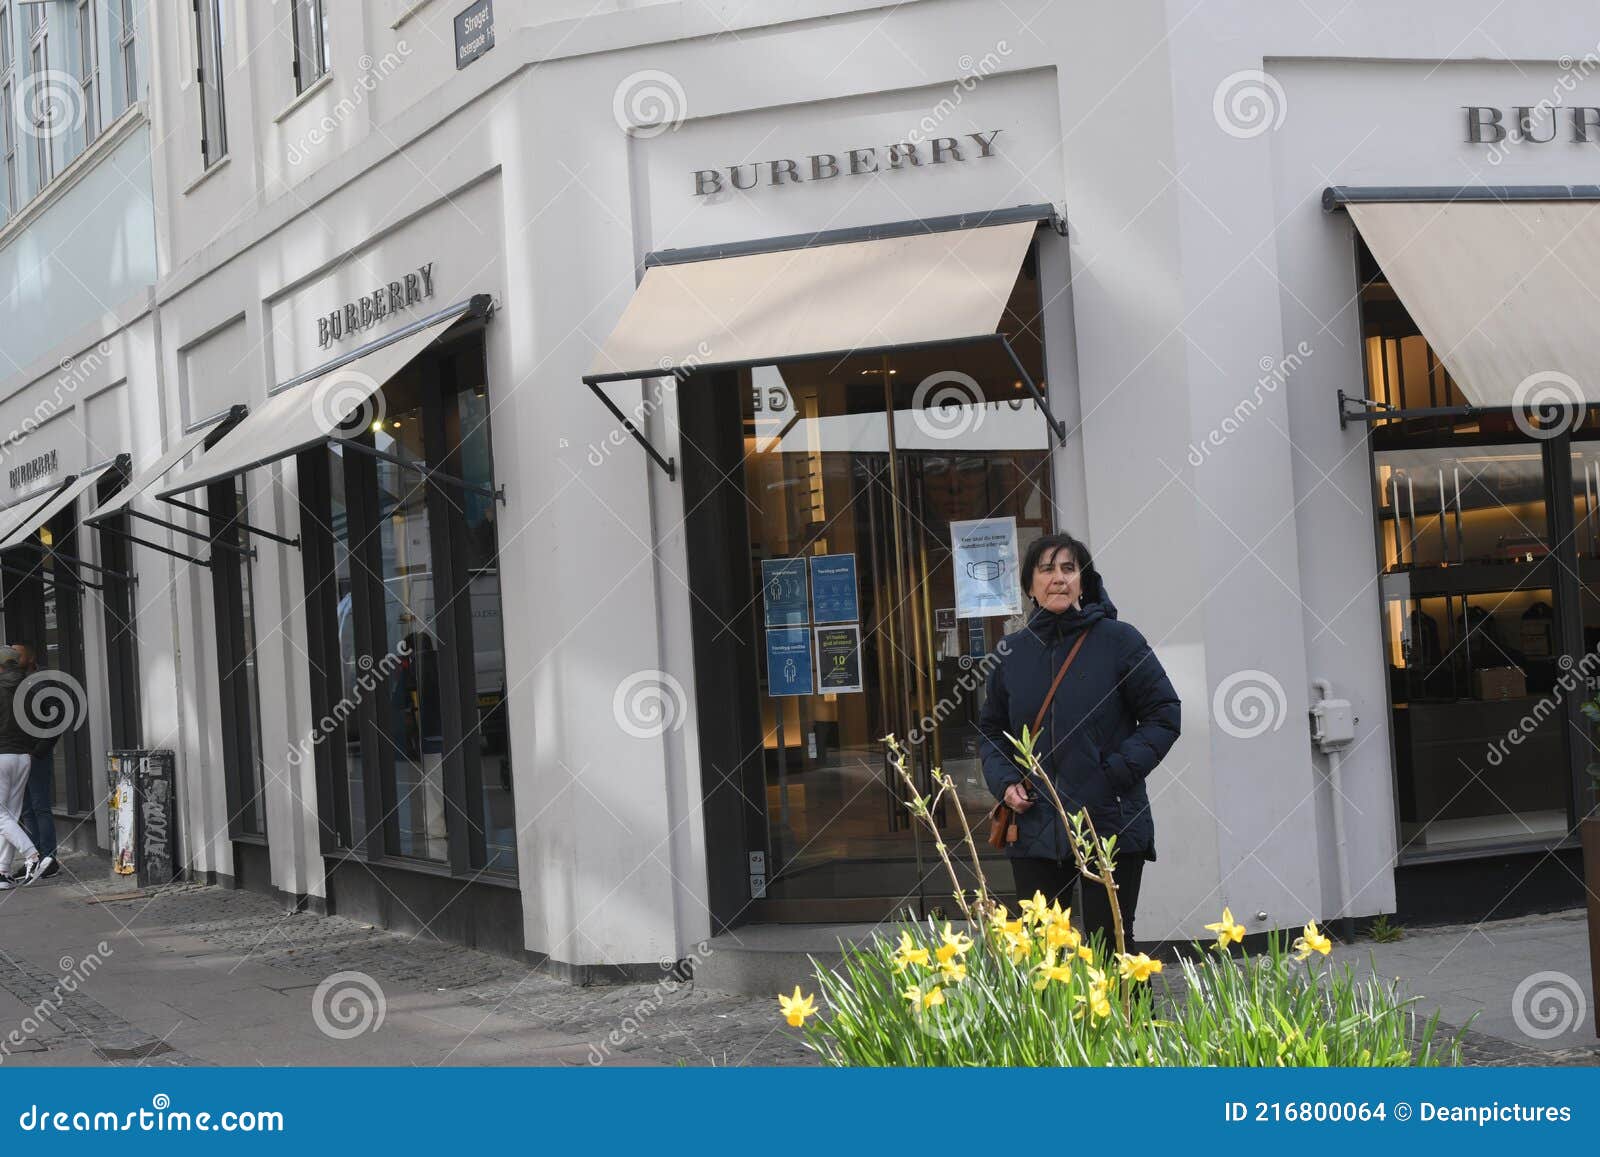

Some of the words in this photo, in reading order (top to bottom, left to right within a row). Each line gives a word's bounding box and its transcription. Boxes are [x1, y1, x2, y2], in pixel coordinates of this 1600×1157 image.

[689, 129, 1005, 196] BURBERRY
[317, 262, 433, 347] BURBERRY
[833, 655, 846, 665] 10
